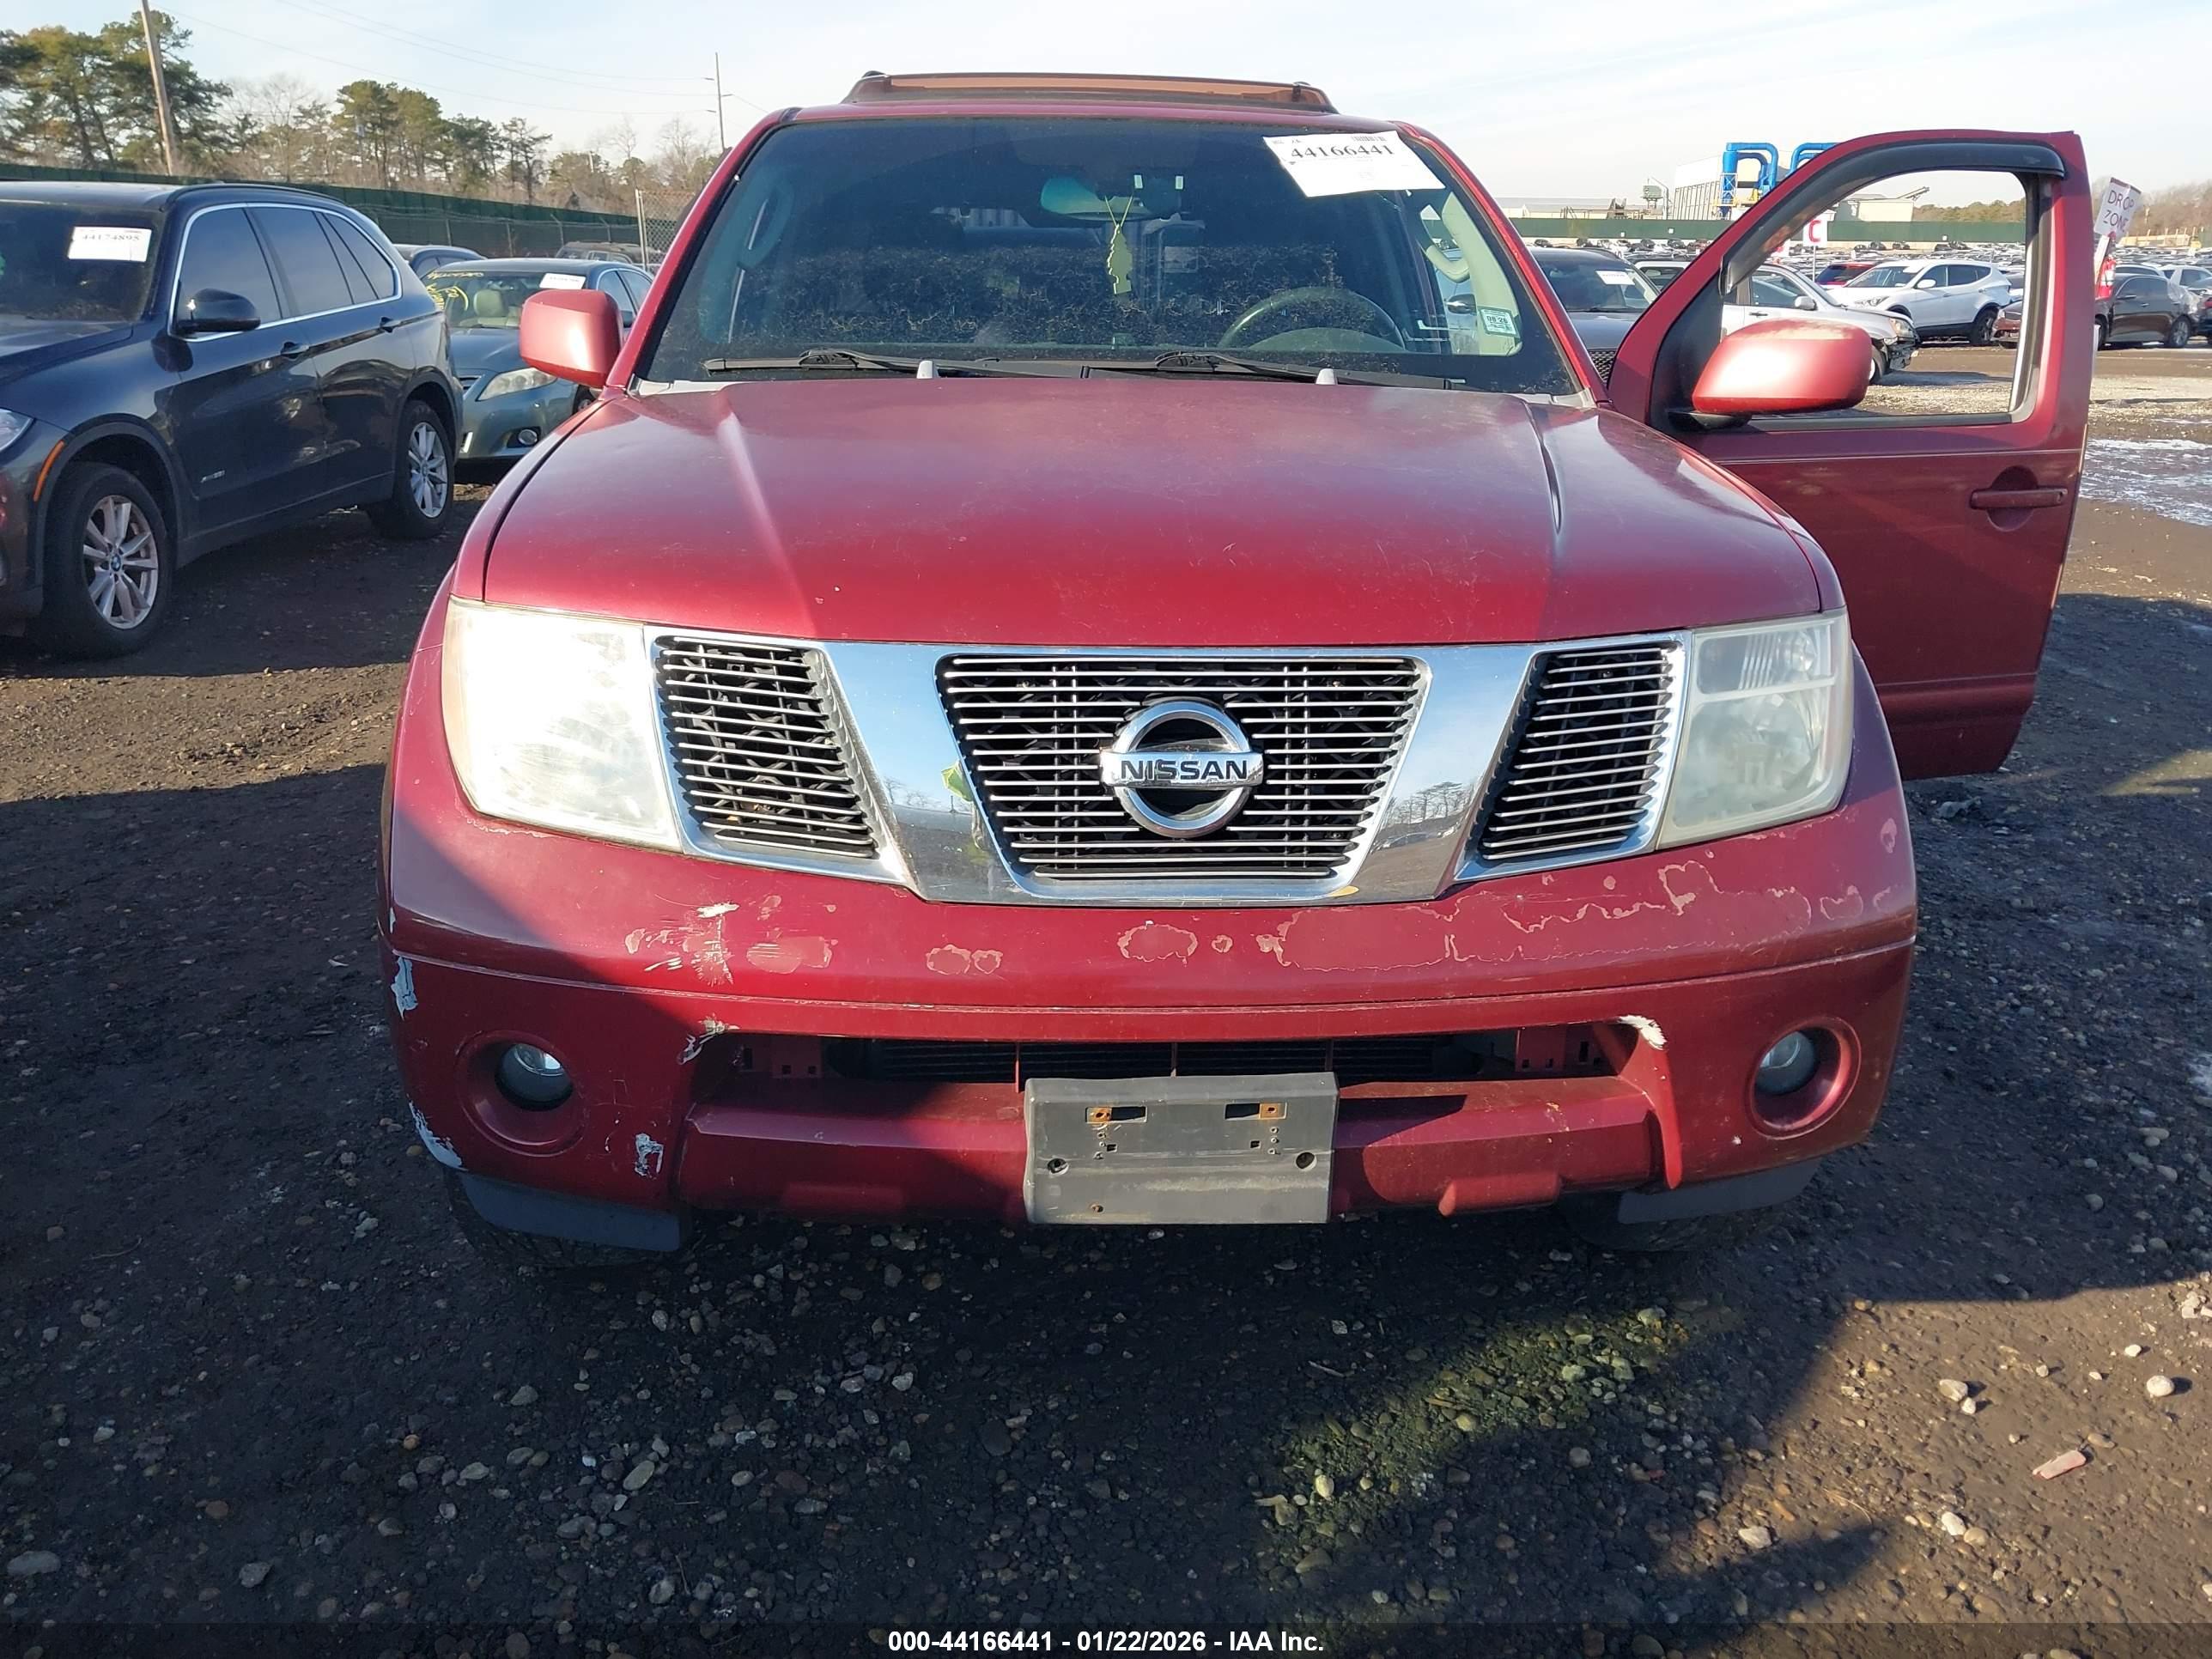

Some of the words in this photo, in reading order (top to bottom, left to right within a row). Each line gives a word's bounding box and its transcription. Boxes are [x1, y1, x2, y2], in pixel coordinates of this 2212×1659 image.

[1291, 144, 1395, 160] 44166441
[2107, 190, 2135, 210] DROP
[1808, 219, 1821, 243] C
[2102, 209, 2129, 233] ZONE
[1121, 759, 1248, 781] NISSAN
